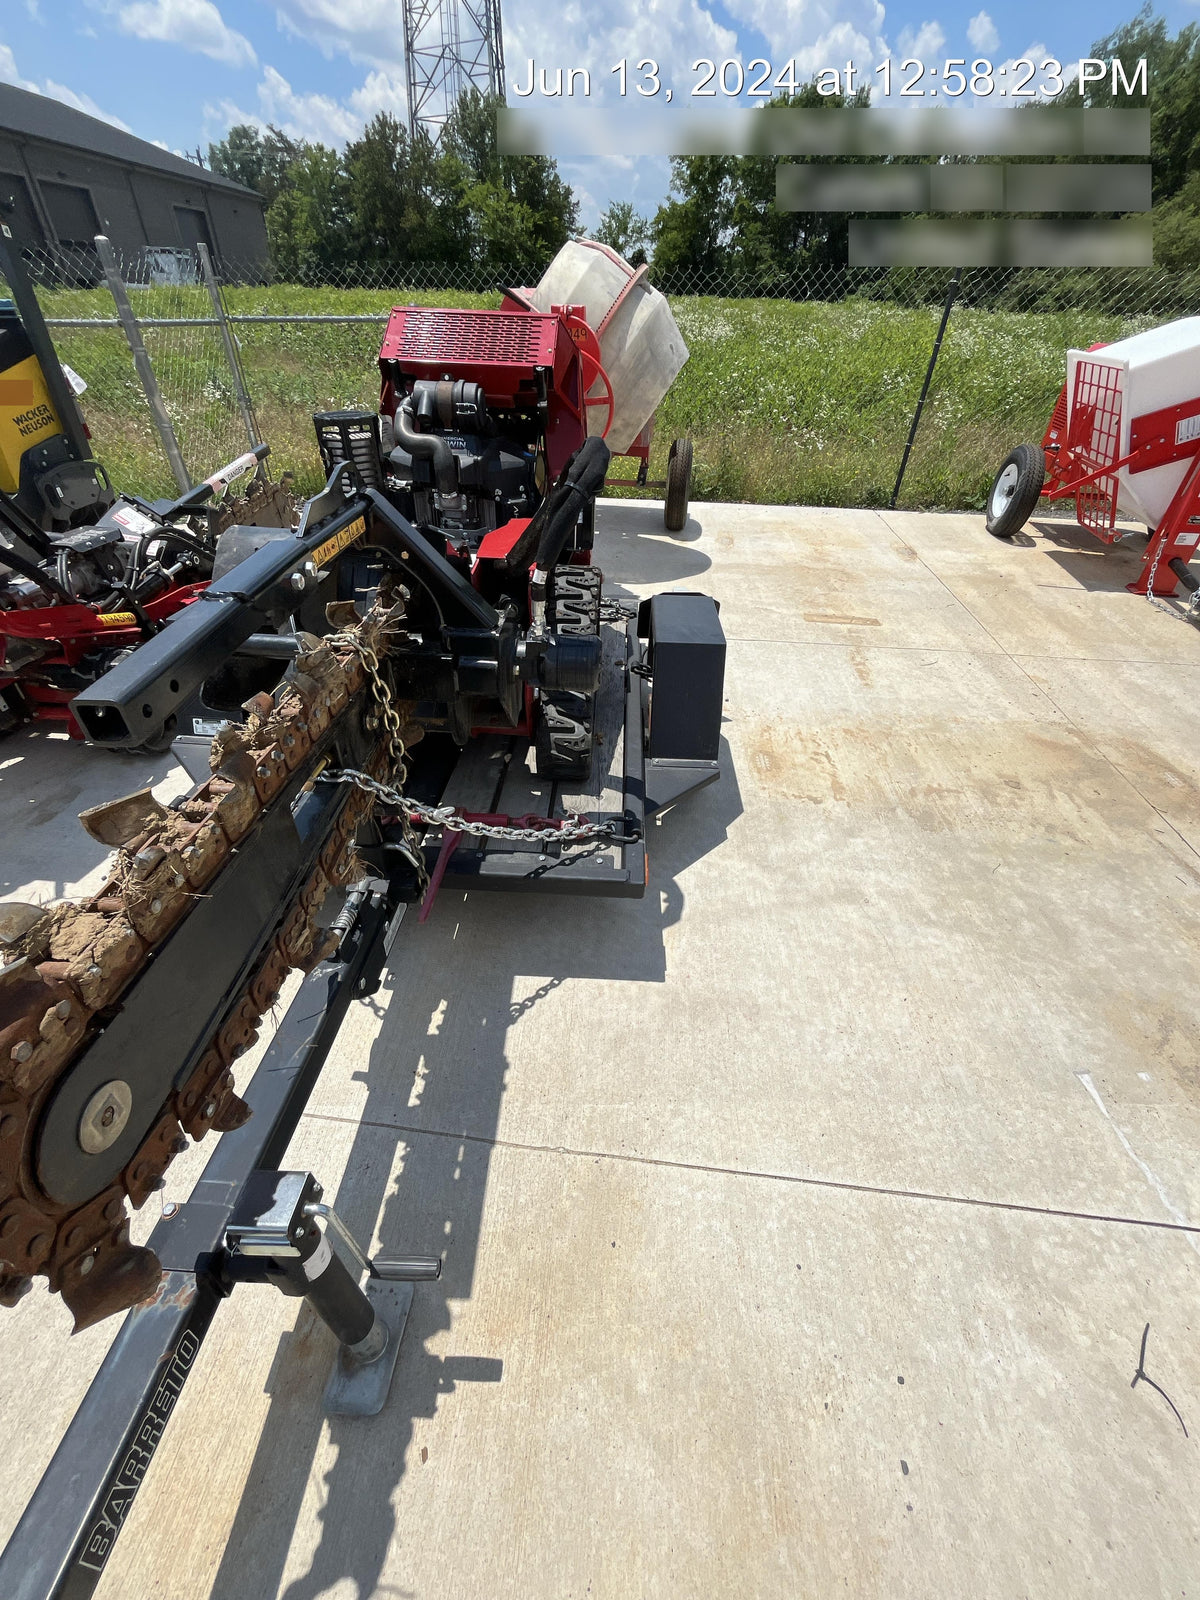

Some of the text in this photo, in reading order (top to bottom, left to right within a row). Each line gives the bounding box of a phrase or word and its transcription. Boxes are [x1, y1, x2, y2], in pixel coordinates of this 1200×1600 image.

[12, 404, 50, 426] WACKER
[18, 413, 55, 437] NEUSON
[79, 1329, 199, 1571] BARRETO
